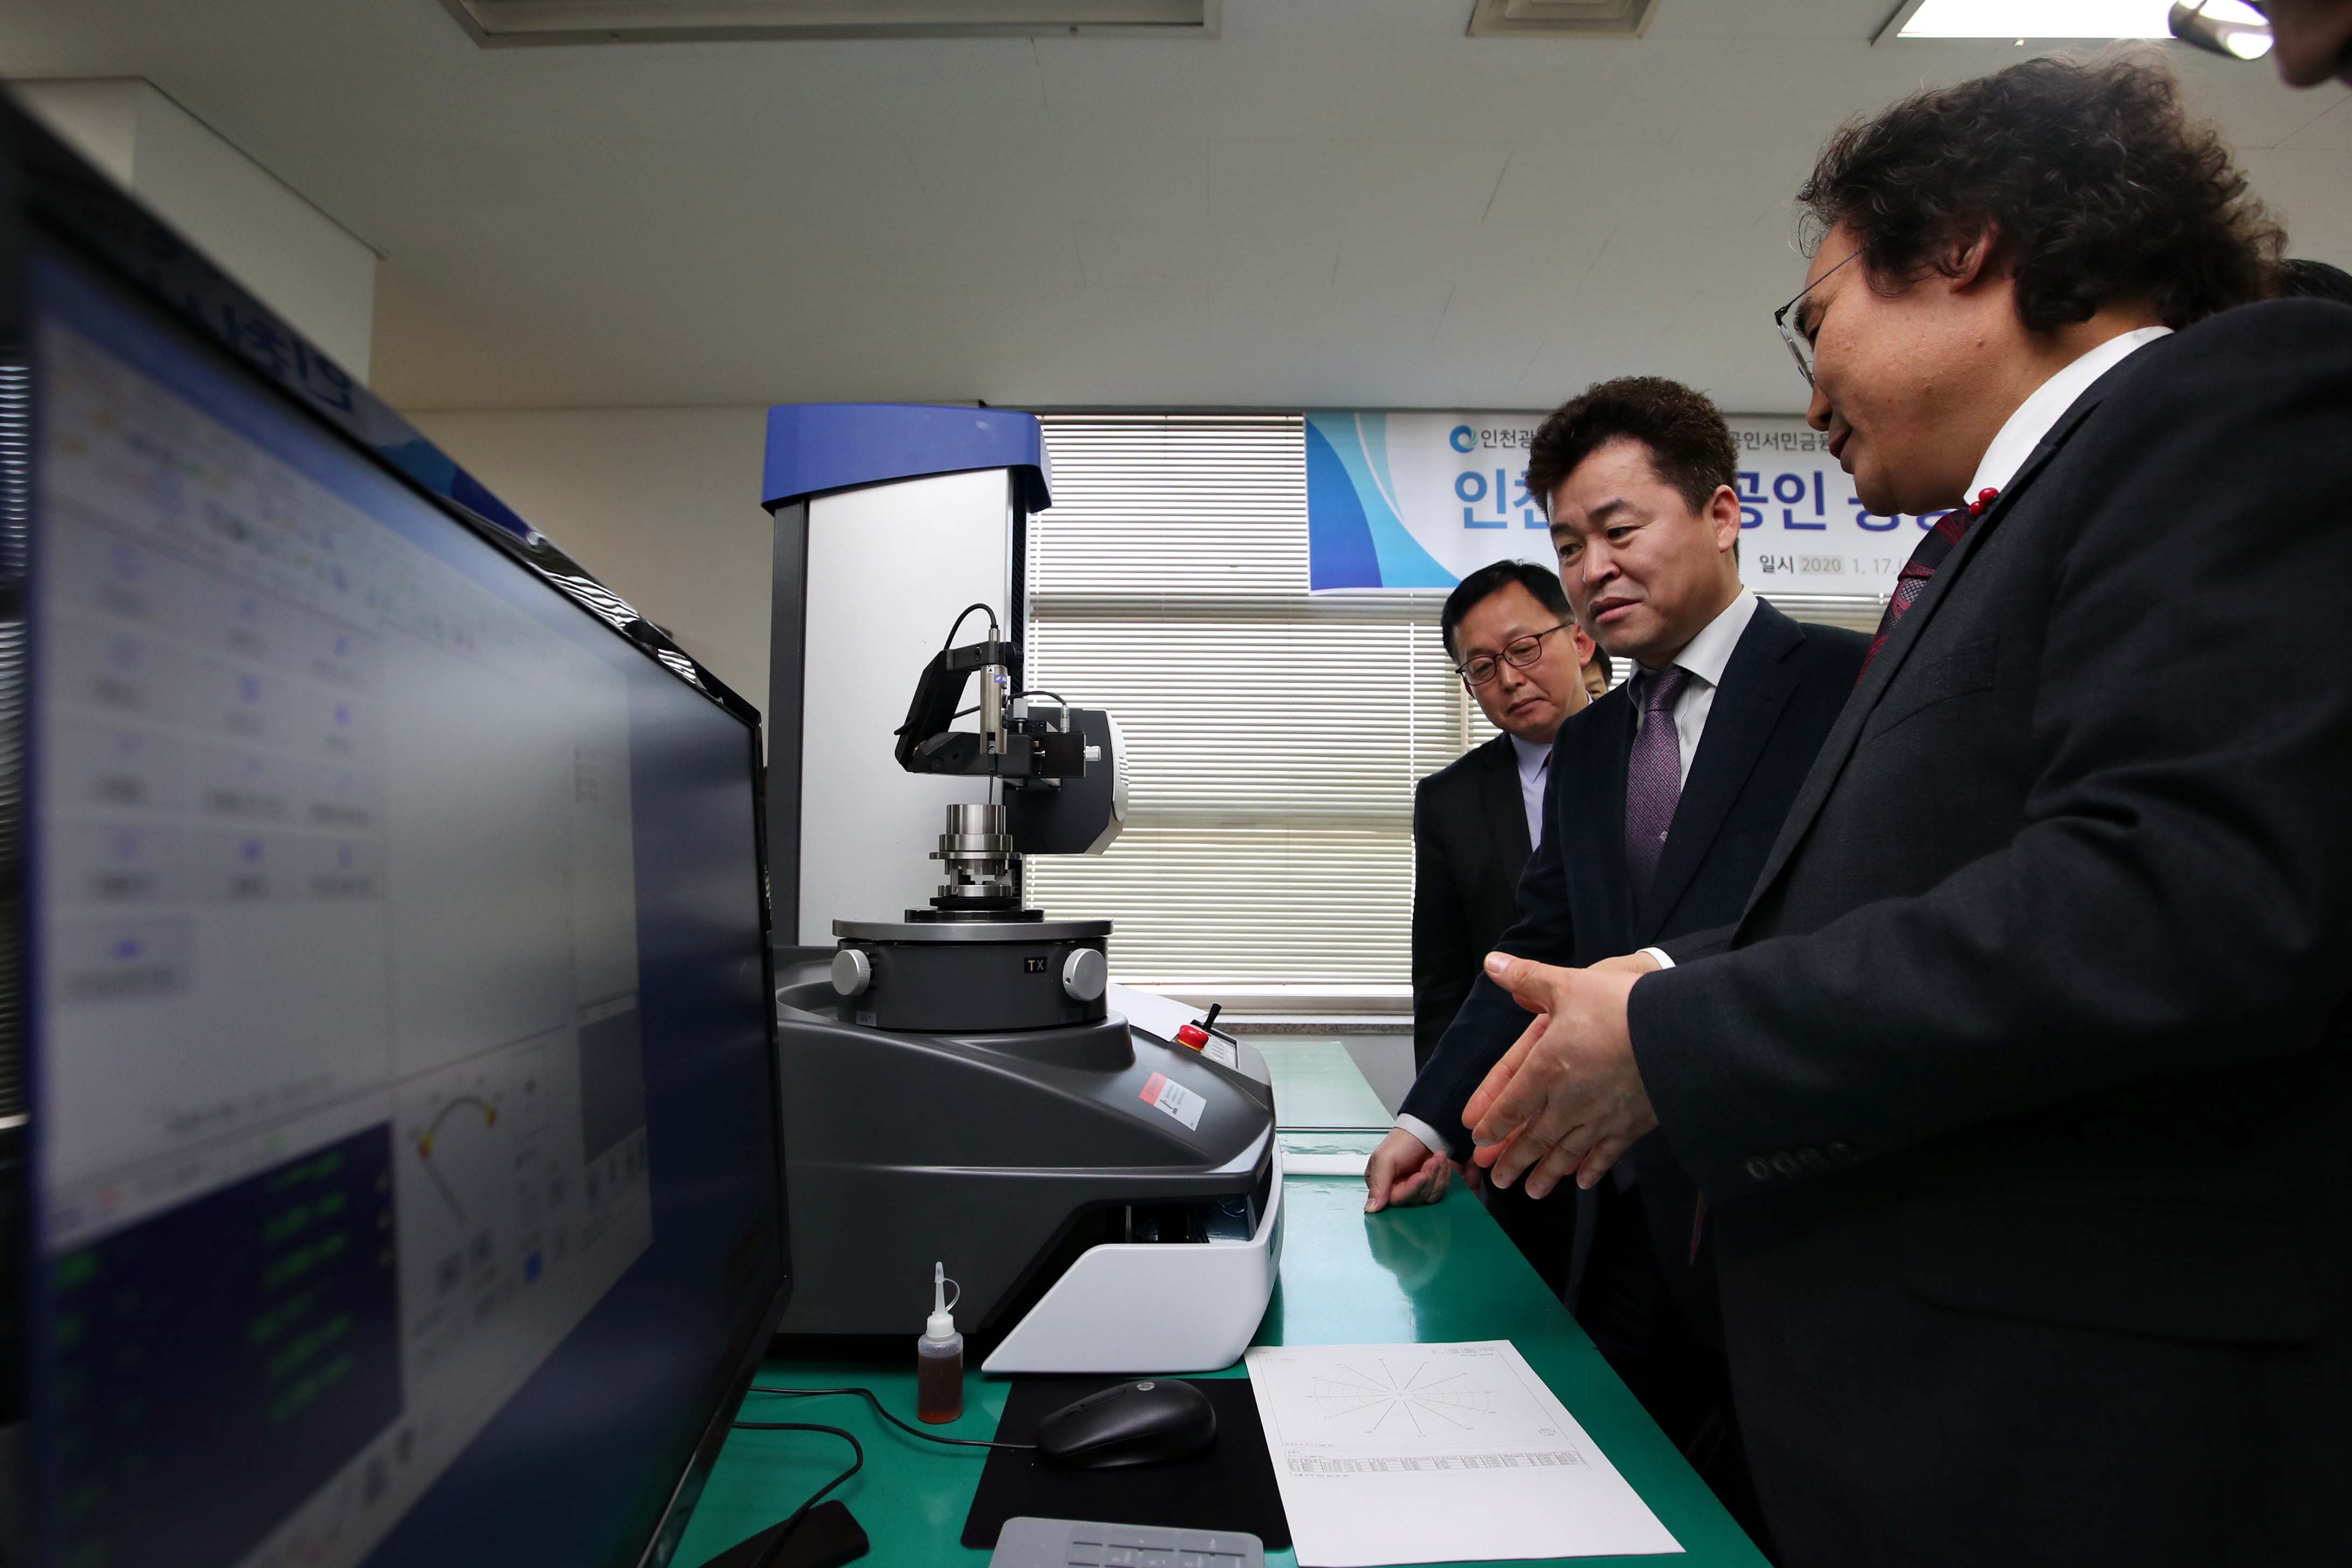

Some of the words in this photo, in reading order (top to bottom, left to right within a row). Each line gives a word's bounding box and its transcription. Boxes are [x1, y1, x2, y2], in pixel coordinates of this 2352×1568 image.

[1760, 555, 1794, 573] 일시
[1801, 557, 1842, 572] 2020
[1027, 960, 1044, 971] TX
